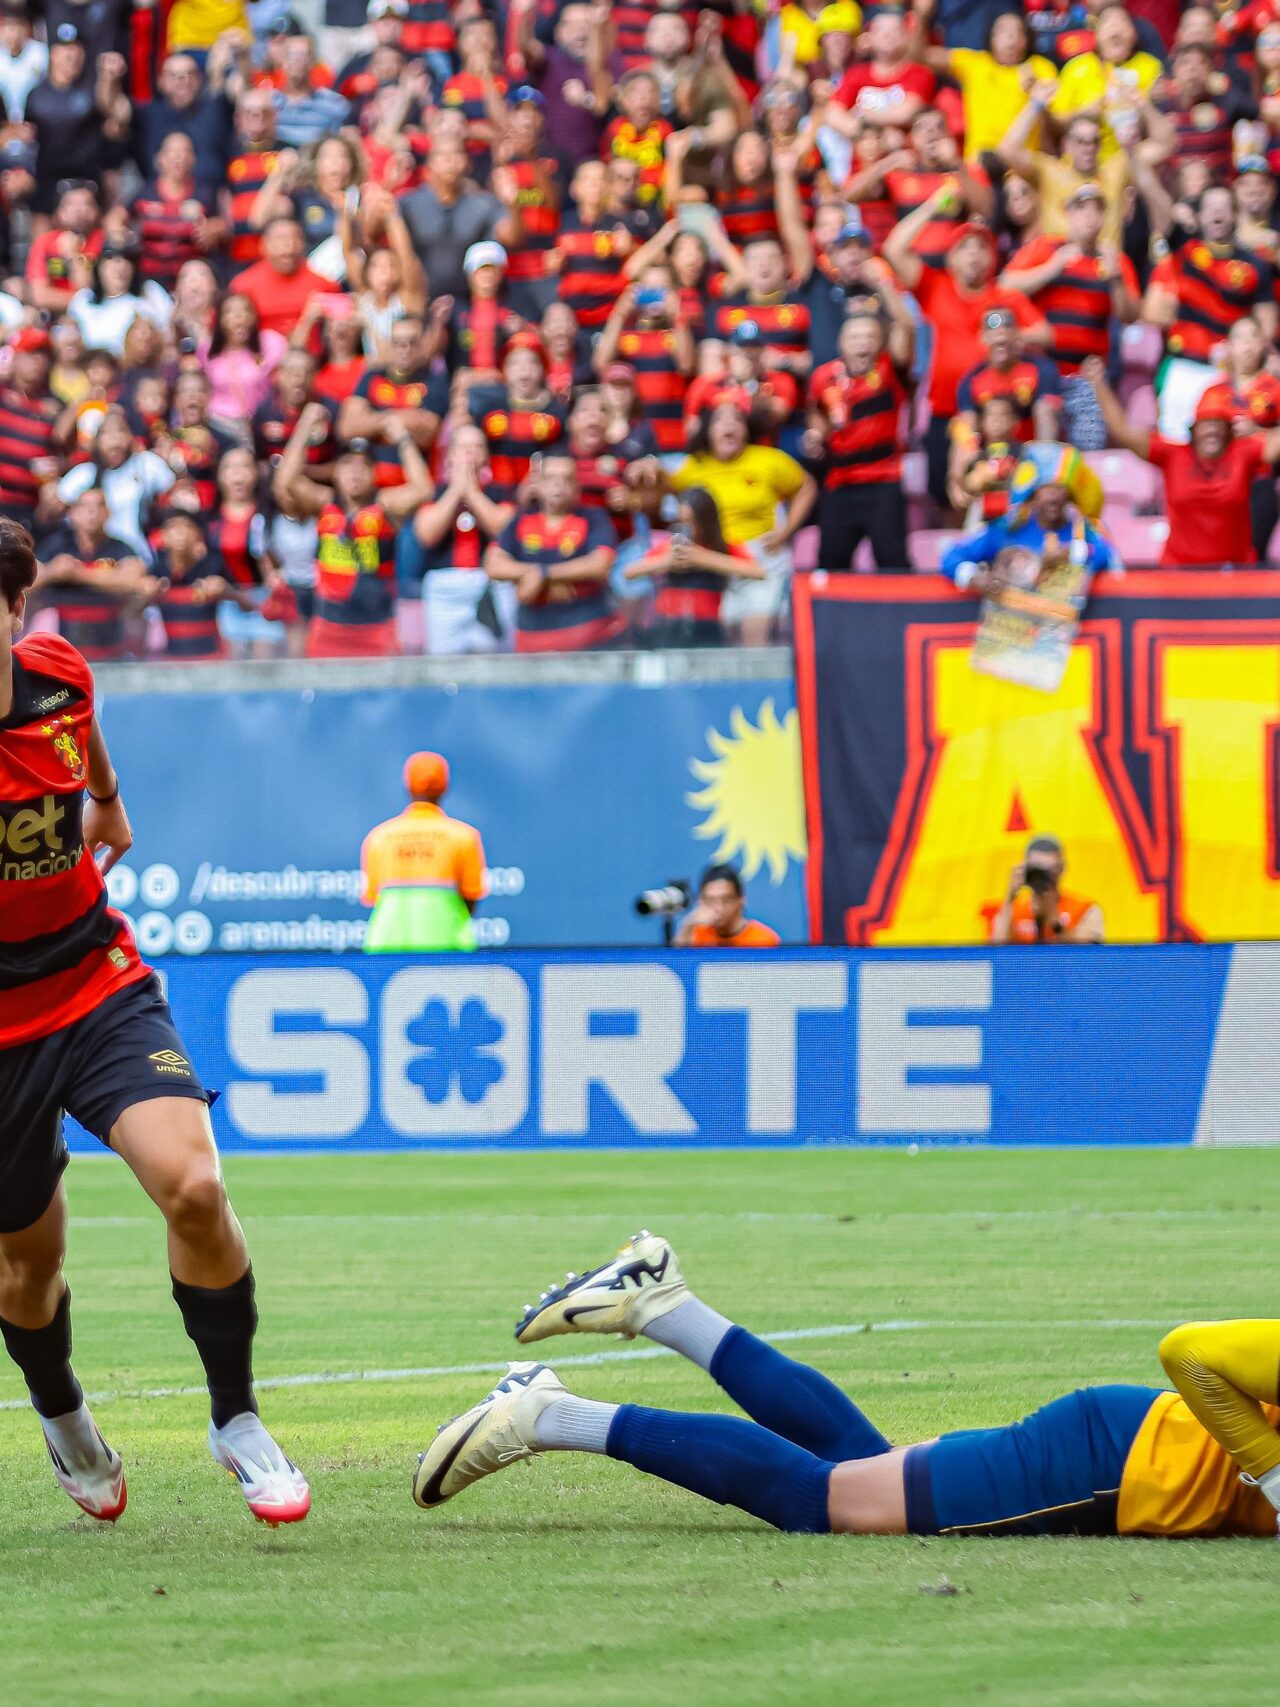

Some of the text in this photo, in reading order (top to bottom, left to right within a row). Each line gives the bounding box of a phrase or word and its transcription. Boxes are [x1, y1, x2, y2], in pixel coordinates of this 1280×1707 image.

[39, 689, 70, 710] HEBRON
[226, 962, 992, 1140] SORTE
[157, 1065, 191, 1076] umbro
